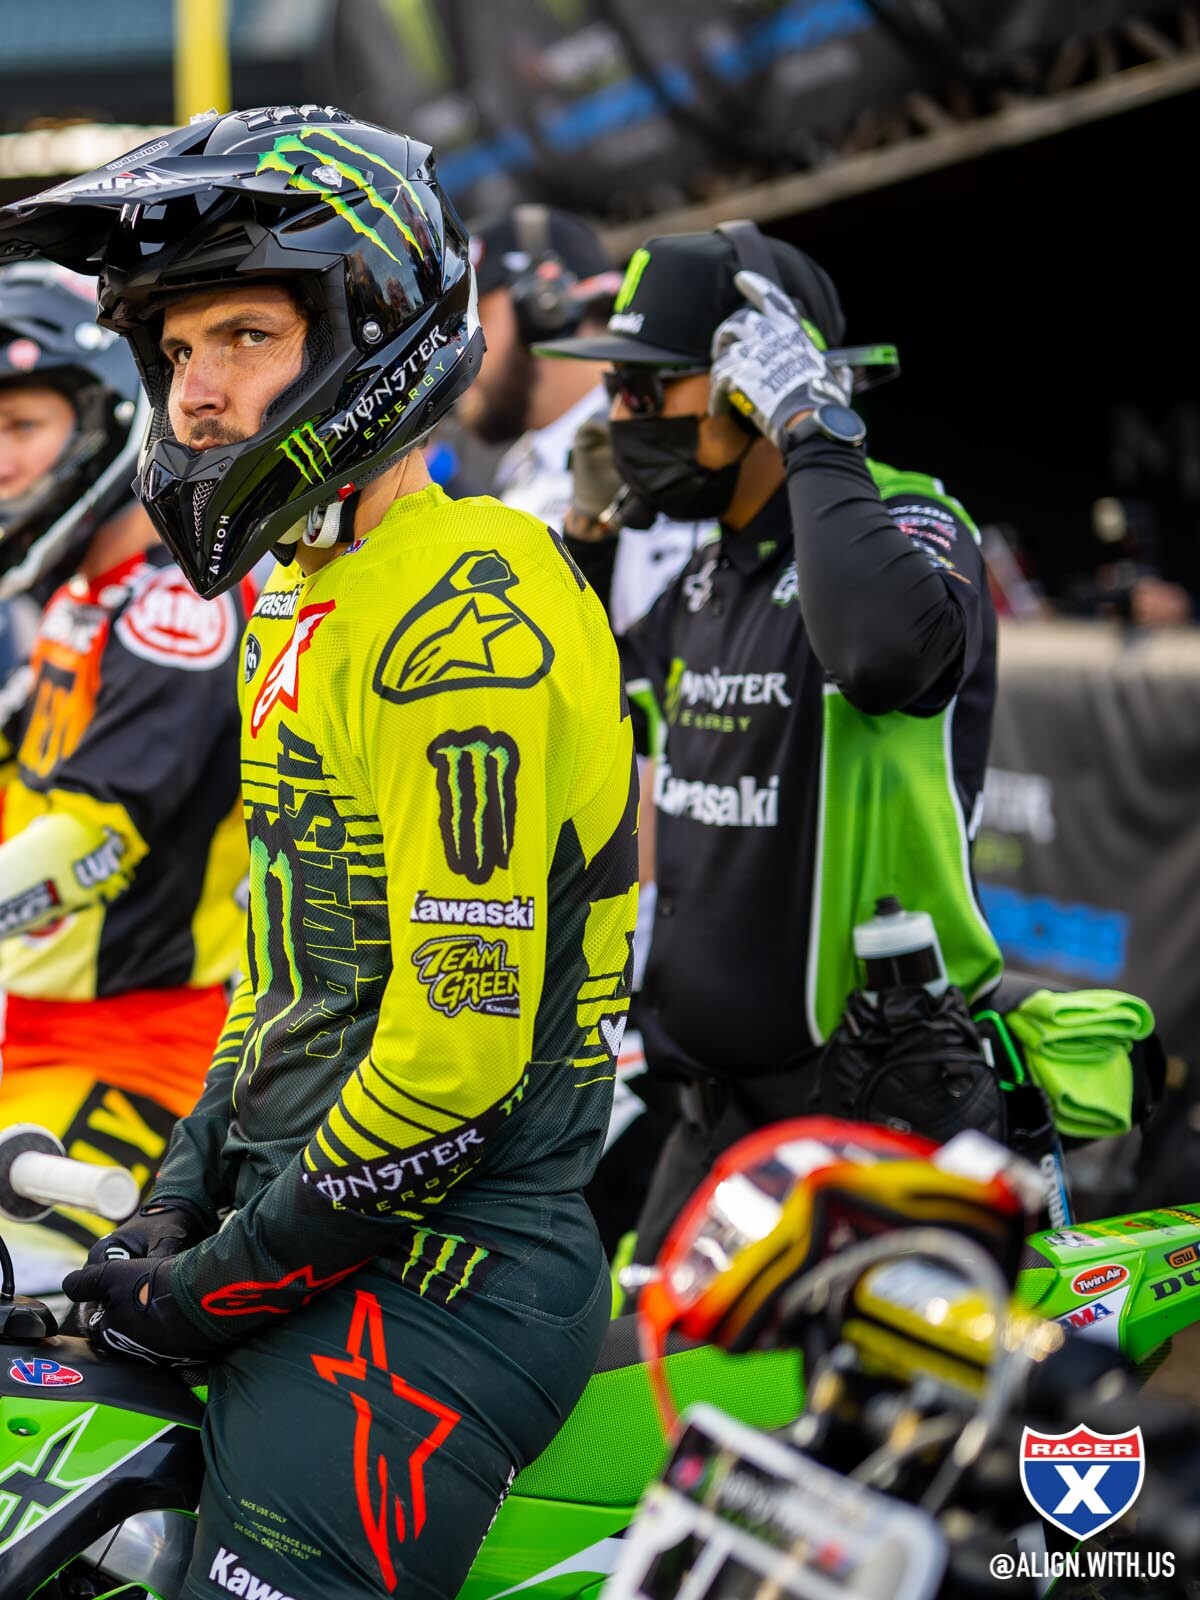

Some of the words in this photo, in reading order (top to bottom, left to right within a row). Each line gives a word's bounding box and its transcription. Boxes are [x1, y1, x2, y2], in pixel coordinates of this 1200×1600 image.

[330, 324, 448, 440] MONSTER
[363, 361, 446, 440] ENERGY
[208, 514, 230, 575] AIROH
[416, 939, 502, 978] TEAM
[433, 969, 520, 1010] GREEN
[303, 1128, 485, 1202] ONSTER
[332, 1165, 461, 1216] EERGY
[1077, 1276, 1106, 1294] Twin
[1106, 1267, 1123, 1282] Air
[11, 1357, 61, 1385] VP
[269, 1511, 288, 1524] ONLY
